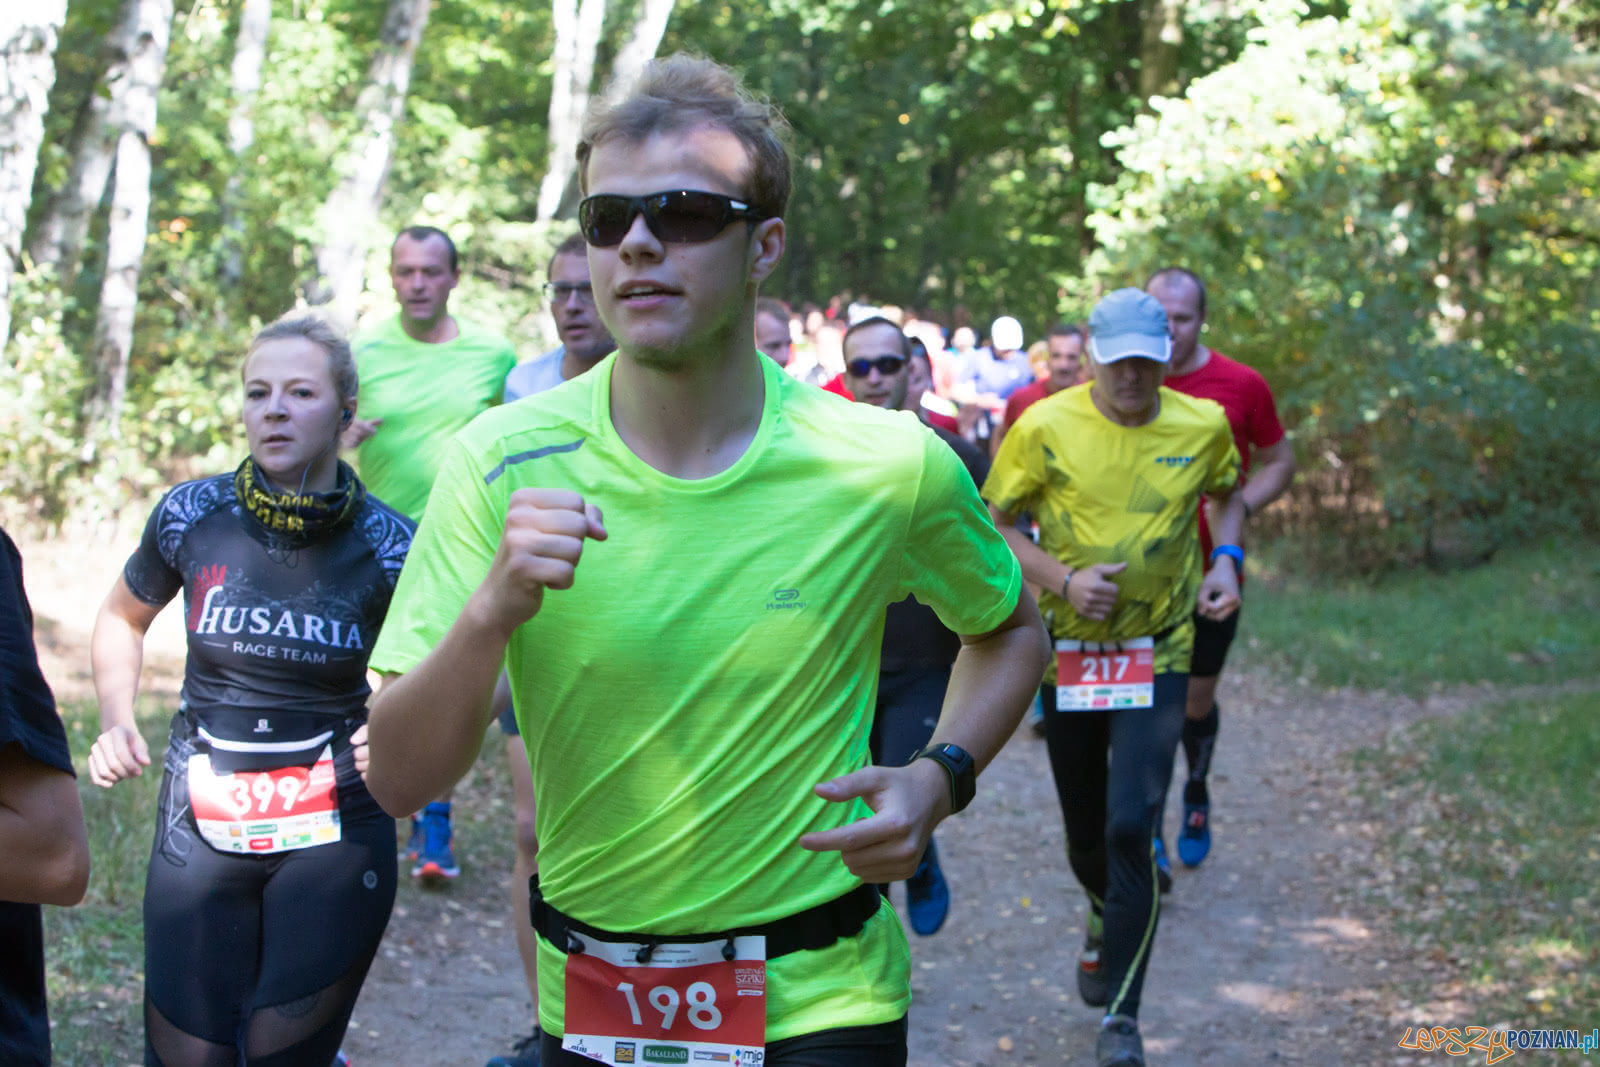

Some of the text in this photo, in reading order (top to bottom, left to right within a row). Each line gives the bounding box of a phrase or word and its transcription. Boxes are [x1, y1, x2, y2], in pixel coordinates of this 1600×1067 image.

[196, 585, 364, 650] HUSARIA
[233, 641, 327, 665] RACE TEAM
[1081, 655, 1131, 682] 217
[229, 774, 301, 816] 399
[616, 981, 722, 1030] 198
[645, 1048, 688, 1060] BAKALLAND
